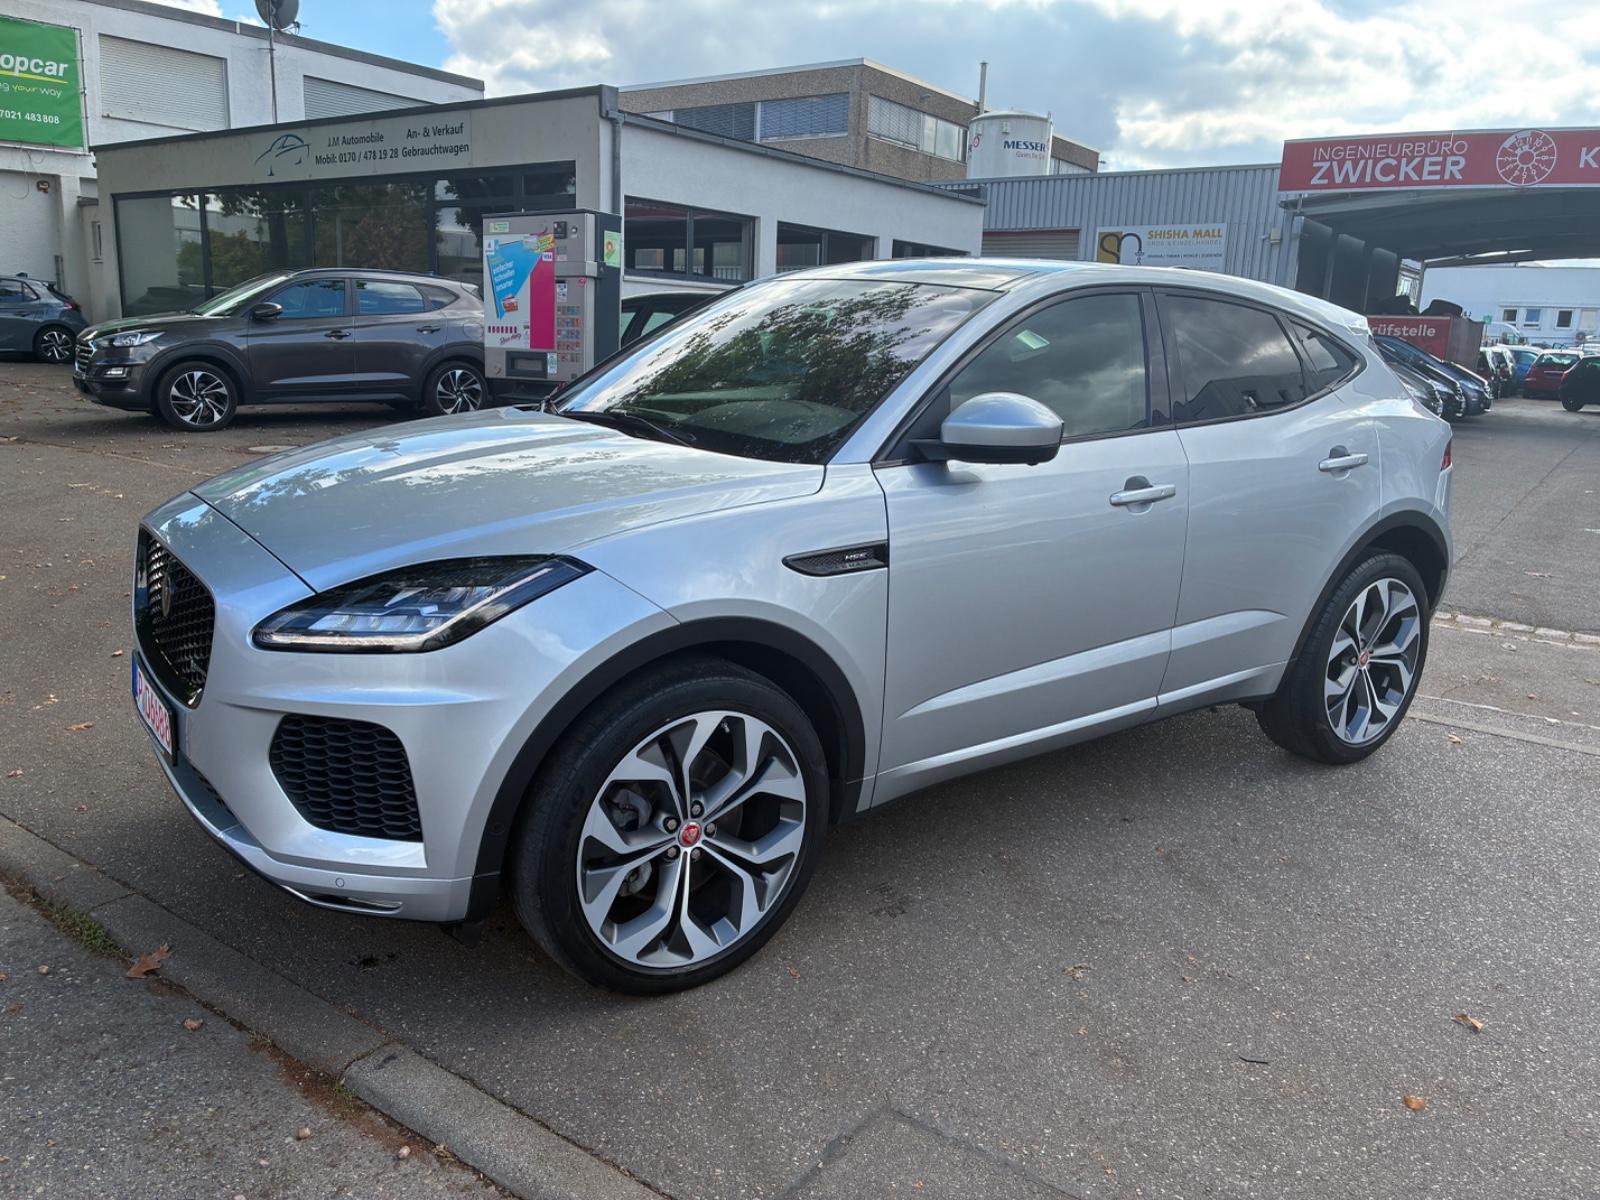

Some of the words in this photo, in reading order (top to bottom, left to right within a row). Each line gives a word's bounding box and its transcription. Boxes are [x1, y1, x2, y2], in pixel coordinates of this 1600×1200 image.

[0, 54, 69, 77] opcar
[12, 83, 38, 93] your
[39, 88, 62, 98] way
[341, 132, 384, 145] Automobile
[406, 128, 421, 139] An-
[423, 126, 431, 137] &
[432, 122, 464, 136] Verkauf
[401, 142, 469, 158] Gebrauchtwagen
[1003, 139, 1046, 152] MESSER
[1312, 140, 1469, 160] INGENIEURBÜRO
[315, 153, 337, 165] Mobil:
[338, 151, 356, 163] 0170
[363, 149, 377, 161] 478
[378, 149, 388, 160] 19
[389, 148, 399, 159] 28
[1310, 156, 1466, 184] ZWICKER
[1147, 230, 1189, 240] SHISHA
[1191, 228, 1222, 238] MALL
[1369, 324, 1436, 337] rüfstelle
